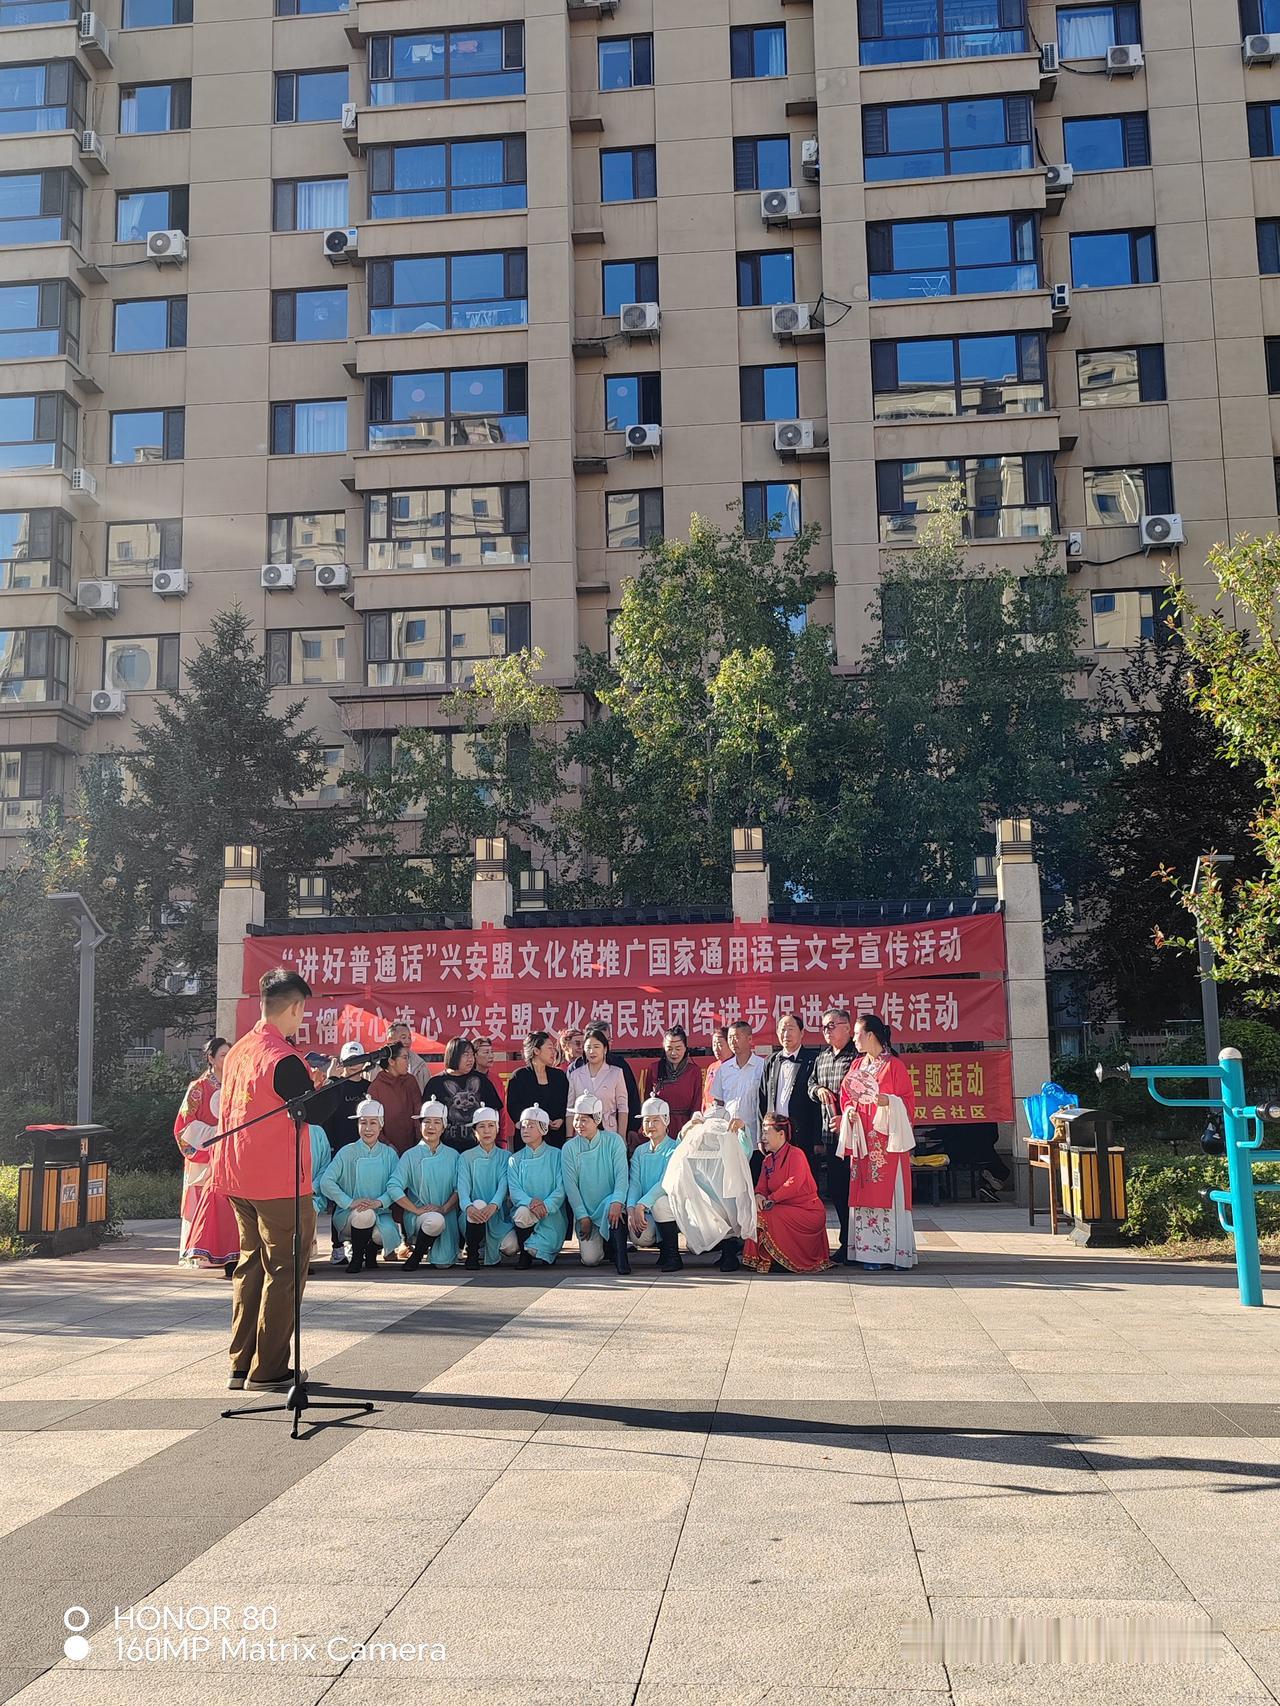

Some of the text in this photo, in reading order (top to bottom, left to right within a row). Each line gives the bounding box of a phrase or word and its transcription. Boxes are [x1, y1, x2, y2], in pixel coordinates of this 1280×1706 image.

[282, 927, 962, 985] “讲好普通话”兴安盟文化馆推广国家通用语言文字宣传活动
[908, 1061, 984, 1097] 主题活动
